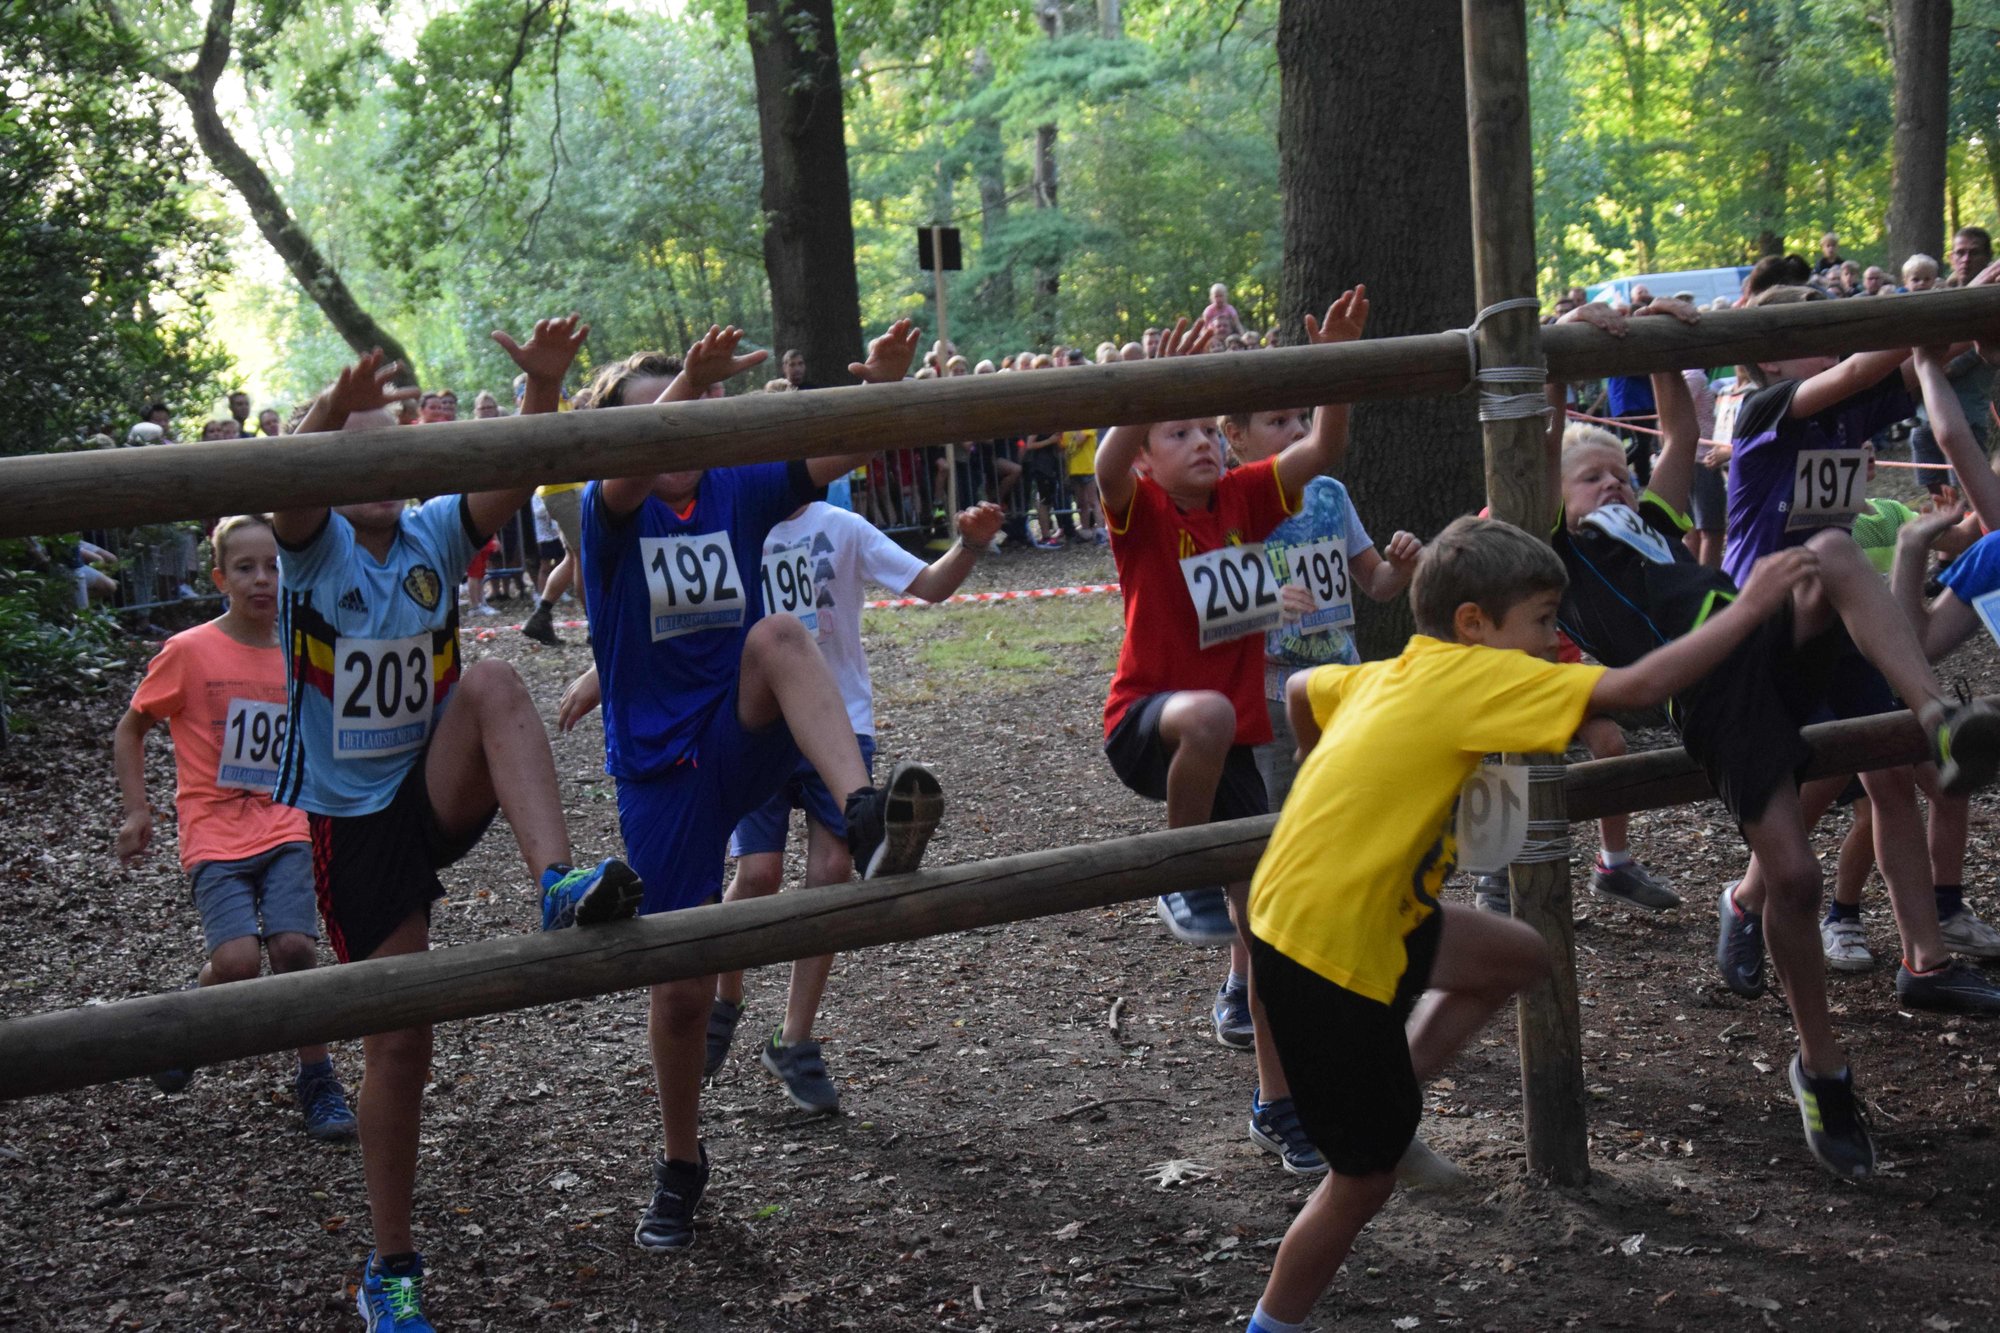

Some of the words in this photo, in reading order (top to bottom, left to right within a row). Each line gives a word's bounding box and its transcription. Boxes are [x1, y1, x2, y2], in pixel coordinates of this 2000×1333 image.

[1800, 457, 1861, 509] 197
[651, 542, 738, 606] 192
[761, 554, 813, 615] 196
[1193, 552, 1278, 621] 202
[1296, 549, 1347, 602] 193
[342, 647, 428, 719] 203
[231, 708, 287, 765] 198
